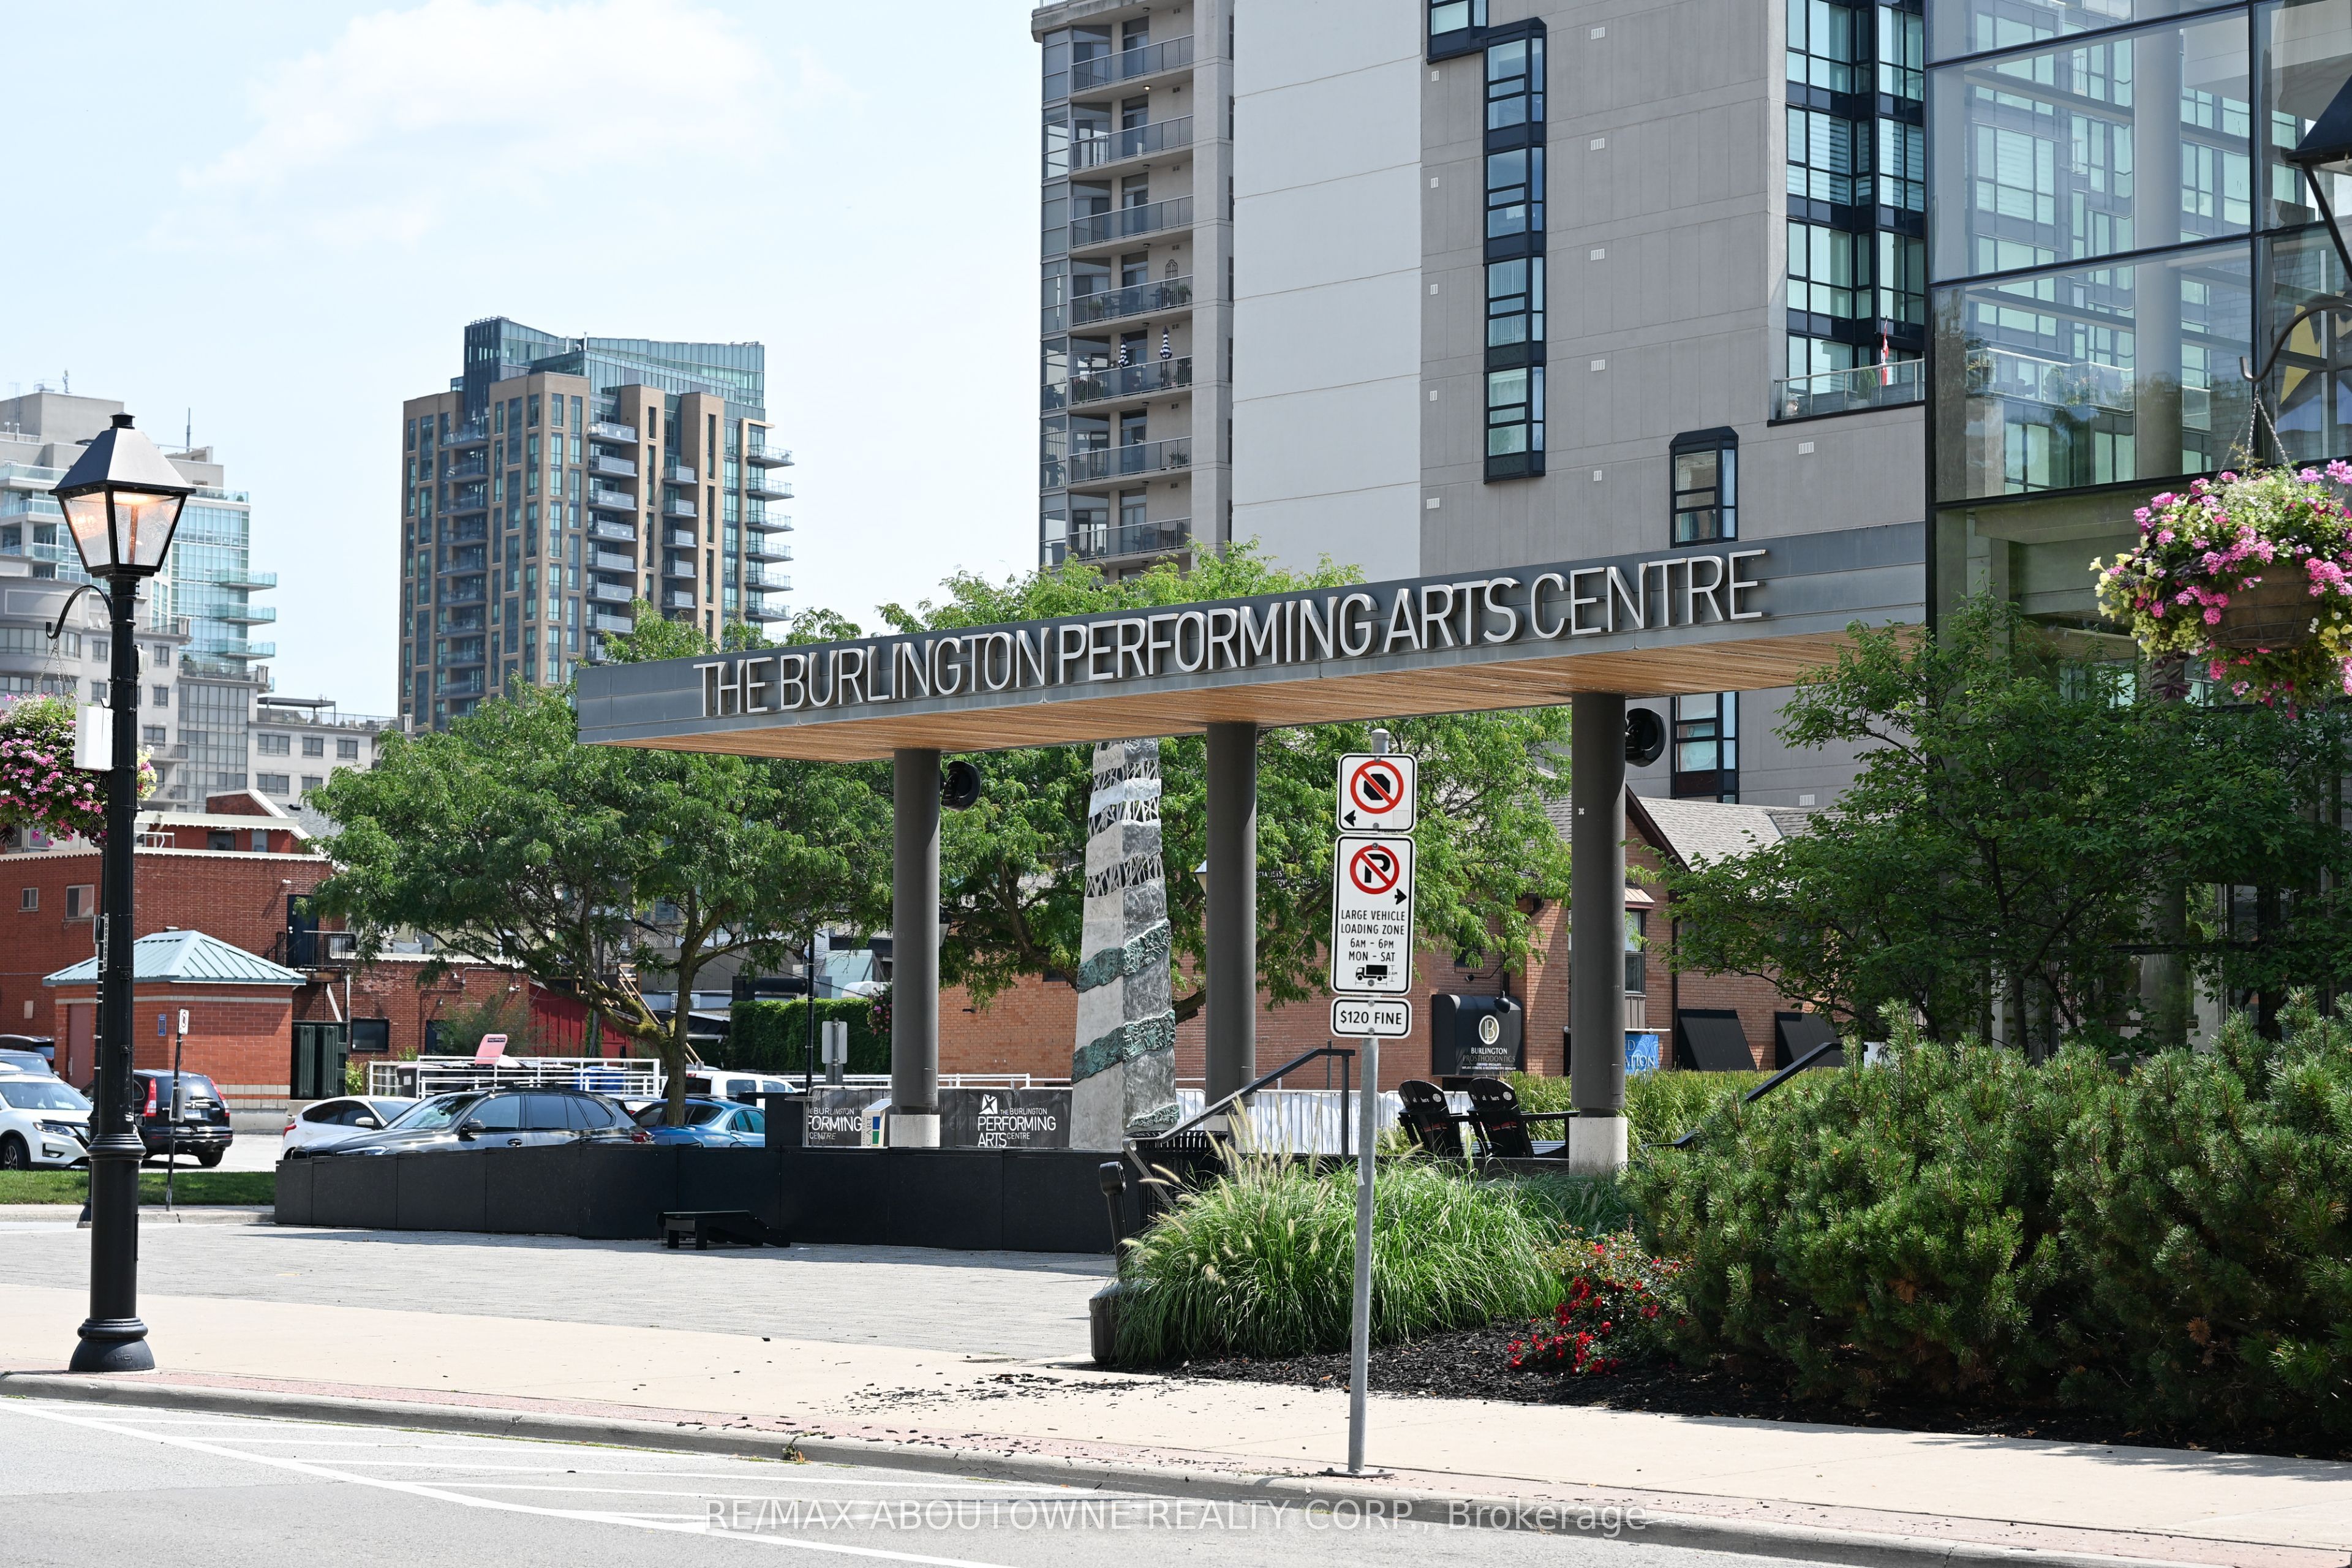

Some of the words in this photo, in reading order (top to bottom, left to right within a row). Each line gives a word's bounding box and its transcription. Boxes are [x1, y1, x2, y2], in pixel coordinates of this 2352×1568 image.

[693, 657, 773, 717] THE
[780, 627, 1050, 710] BURLINGTON
[1059, 593, 1377, 684] PERFORMING
[1383, 577, 1523, 653] ARTS
[1531, 549, 1766, 639] CENTRE
[1341, 910, 1367, 919] LARGE
[1371, 911, 1405, 921] VEHICLE
[1341, 924, 1379, 934] LOADING
[1382, 925, 1404, 935] ZONE
[1350, 938, 1366, 948] 6AM
[1378, 939, 1394, 949] 6PM
[1349, 951, 1368, 961] MON
[1381, 952, 1395, 962] SAT
[1340, 1010, 1369, 1024] $120
[1374, 1012, 1402, 1025] FINE
[978, 1116, 1057, 1131] PERFORMING
[809, 1132, 836, 1140] CENTRE
[978, 1133, 1007, 1147] ARTS
